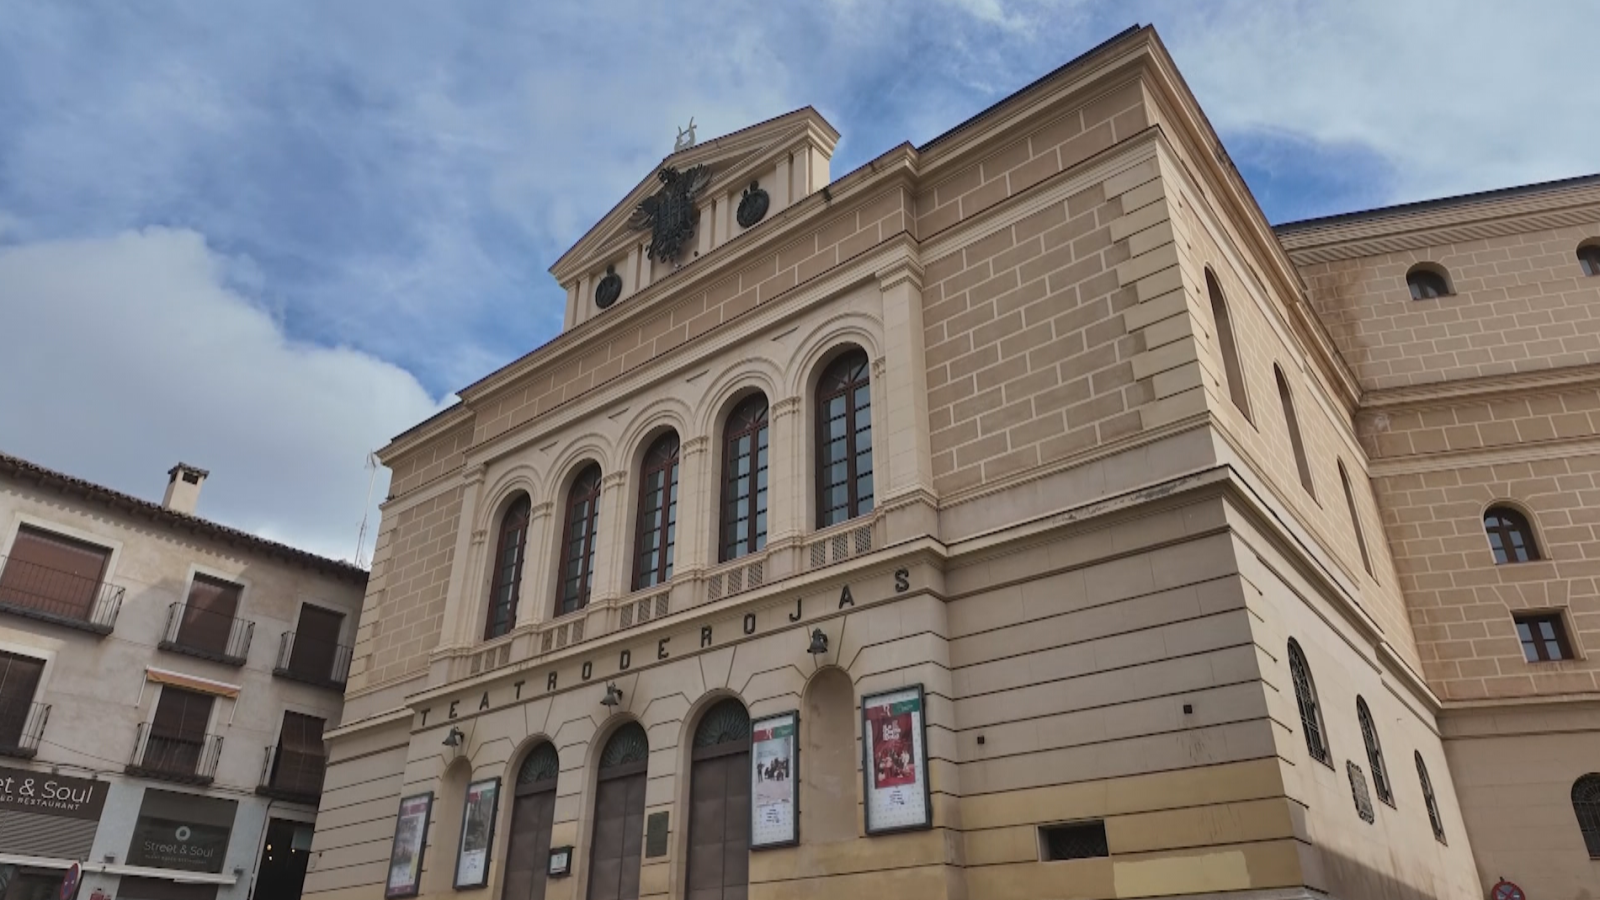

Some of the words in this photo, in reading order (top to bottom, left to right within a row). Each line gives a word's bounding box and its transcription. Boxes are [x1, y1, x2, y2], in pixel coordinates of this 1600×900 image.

[420, 661, 593, 726] TEATRO
[619, 637, 671, 670] DE
[701, 568, 910, 648] ROJAS
[19, 778, 35, 797] &
[41, 781, 93, 803] Soul
[17, 797, 80, 810] RESTAURANT
[144, 840, 177, 854] Street
[179, 844, 188, 854] &
[190, 845, 214, 858] Soul
